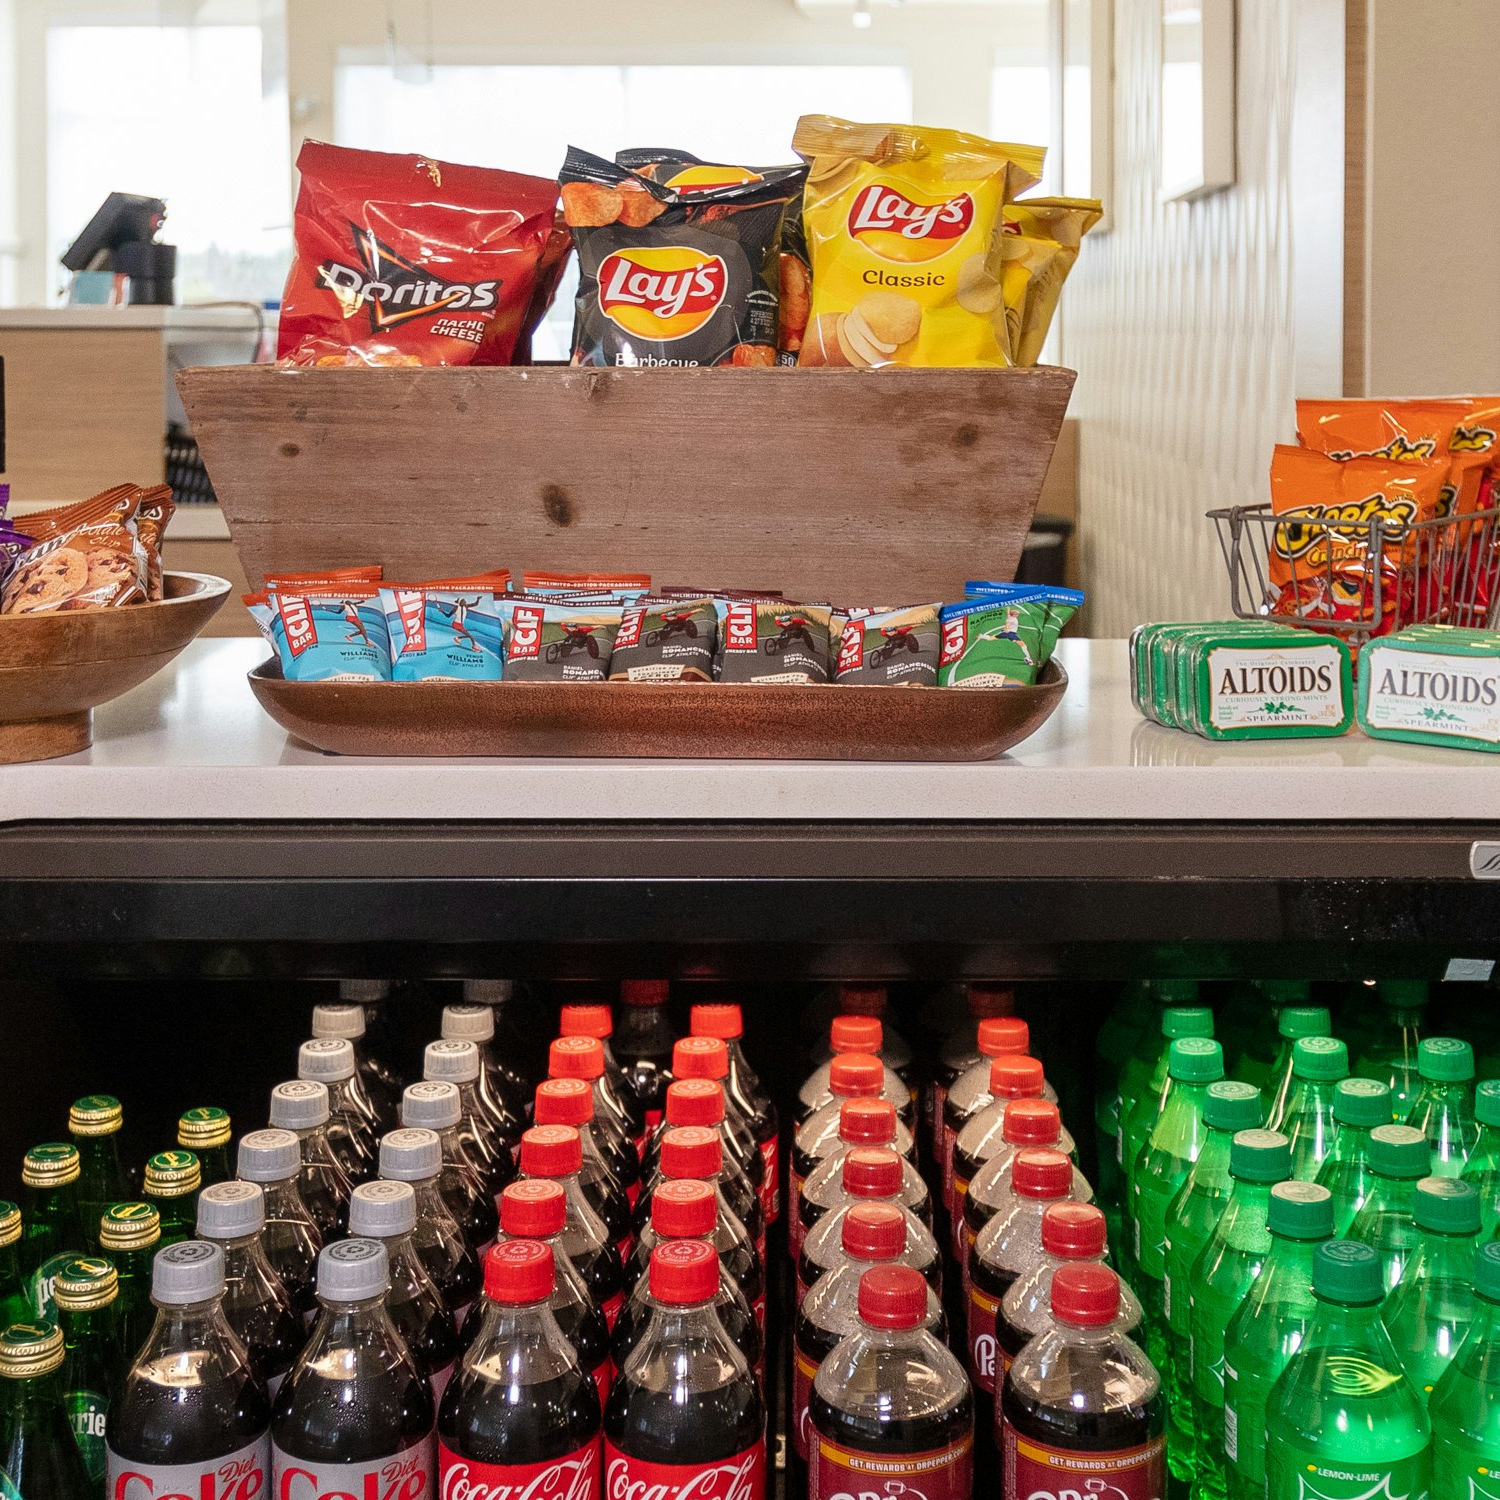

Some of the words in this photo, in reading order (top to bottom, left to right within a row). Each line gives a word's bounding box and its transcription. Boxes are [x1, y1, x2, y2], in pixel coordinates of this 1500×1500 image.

[853, 187, 968, 239] Lay's
[324, 262, 498, 310] Doritos
[862, 270, 945, 288] Classic
[604, 258, 719, 318] Lay's
[436, 318, 485, 332] NACHO
[429, 325, 484, 343] CHEESE
[1274, 493, 1417, 558] Cheetos
[292, 632, 313, 649] BAR
[407, 634, 422, 645] AR
[730, 636, 753, 644] BAR
[340, 651, 379, 659] WILLIAMS
[513, 646, 536, 654] BAR
[446, 654, 484, 664] WILLIAMS
[886, 662, 936, 675] ROMANCHUK
[1218, 665, 1332, 695] ALTOIDS
[1377, 668, 1497, 706] ALTOIDS
[1383, 697, 1429, 706] CURIOUSLY
[1430, 700, 1464, 710] STRONG
[1466, 705, 1492, 714] MINTS
[1246, 714, 1309, 722] SPEARMINT
[1403, 719, 1469, 732] SPEARMINT
[218, 1452, 257, 1483] Diet
[381, 1453, 419, 1483] Diet
[849, 1458, 864, 1469] GET
[865, 1461, 905, 1472] REWARDS
[1049, 1456, 1064, 1467] GET
[1065, 1459, 1106, 1470] REWARDS
[1317, 1467, 1380, 1482] LEMON-LIME
